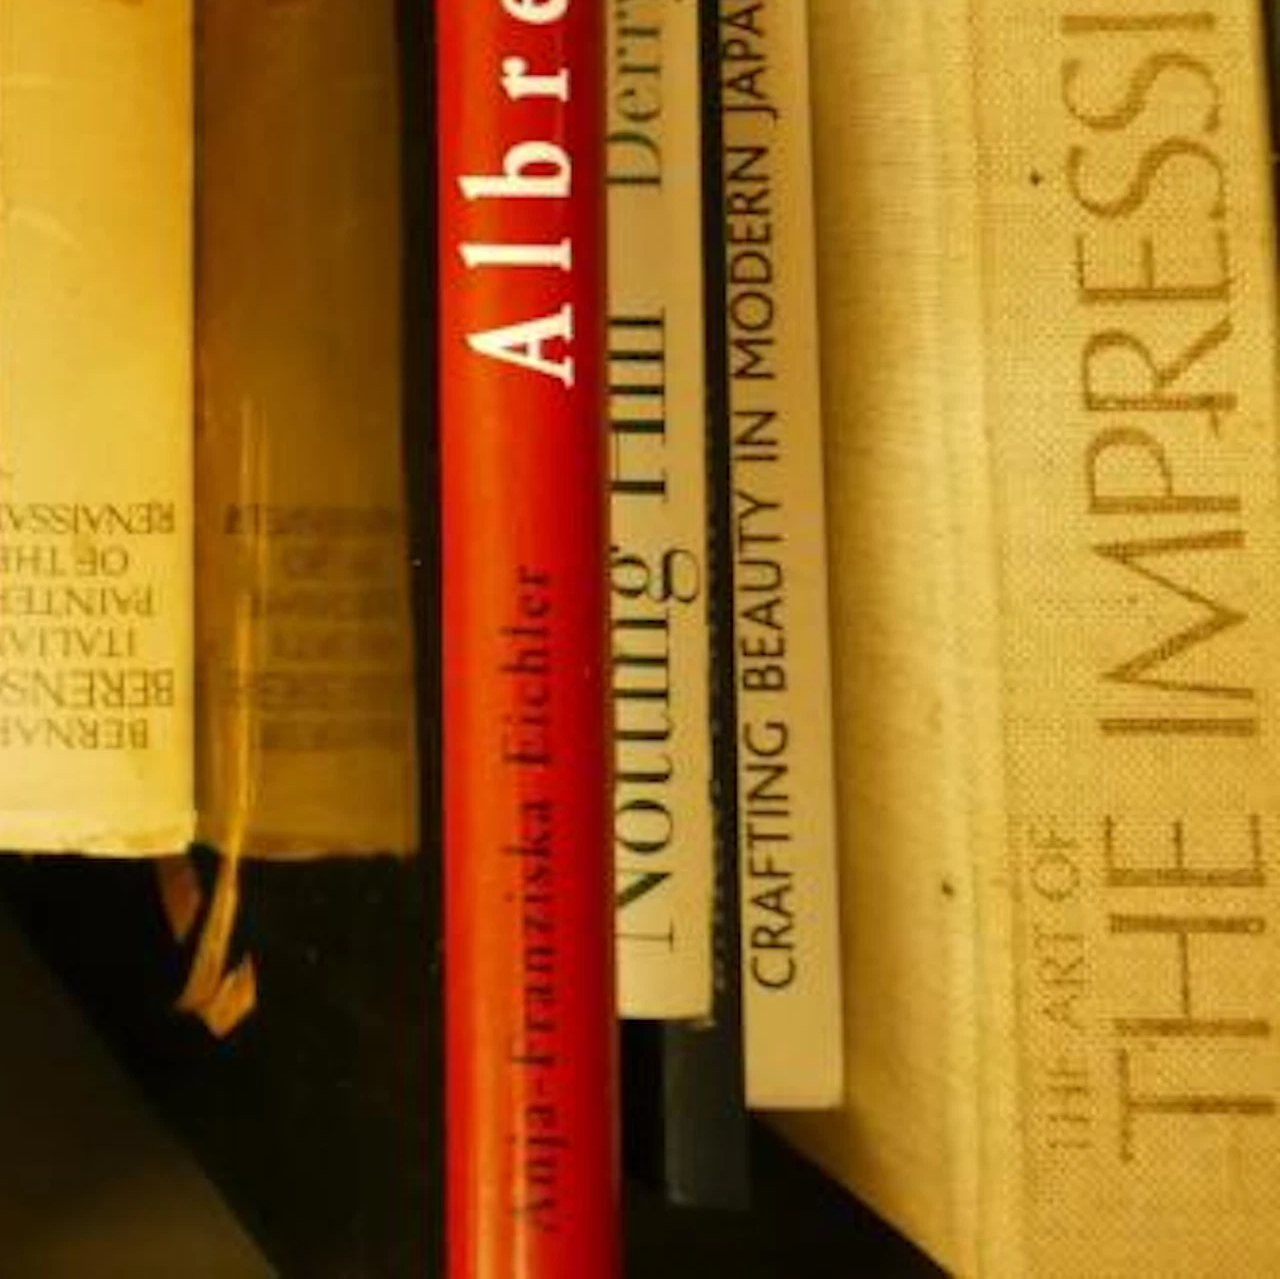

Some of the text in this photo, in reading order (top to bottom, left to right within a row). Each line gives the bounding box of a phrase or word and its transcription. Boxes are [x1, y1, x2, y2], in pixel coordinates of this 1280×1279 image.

[724, 146, 778, 384] MODERN
[732, 410, 781, 465] IN
[75, 545, 131, 578] OF
[737, 492, 788, 695] BEAUTY
[737, 720, 796, 993] CRAFTING
[1030, 814, 1091, 1154] THE ART OF
[1103, 813, 1276, 1167] THE
